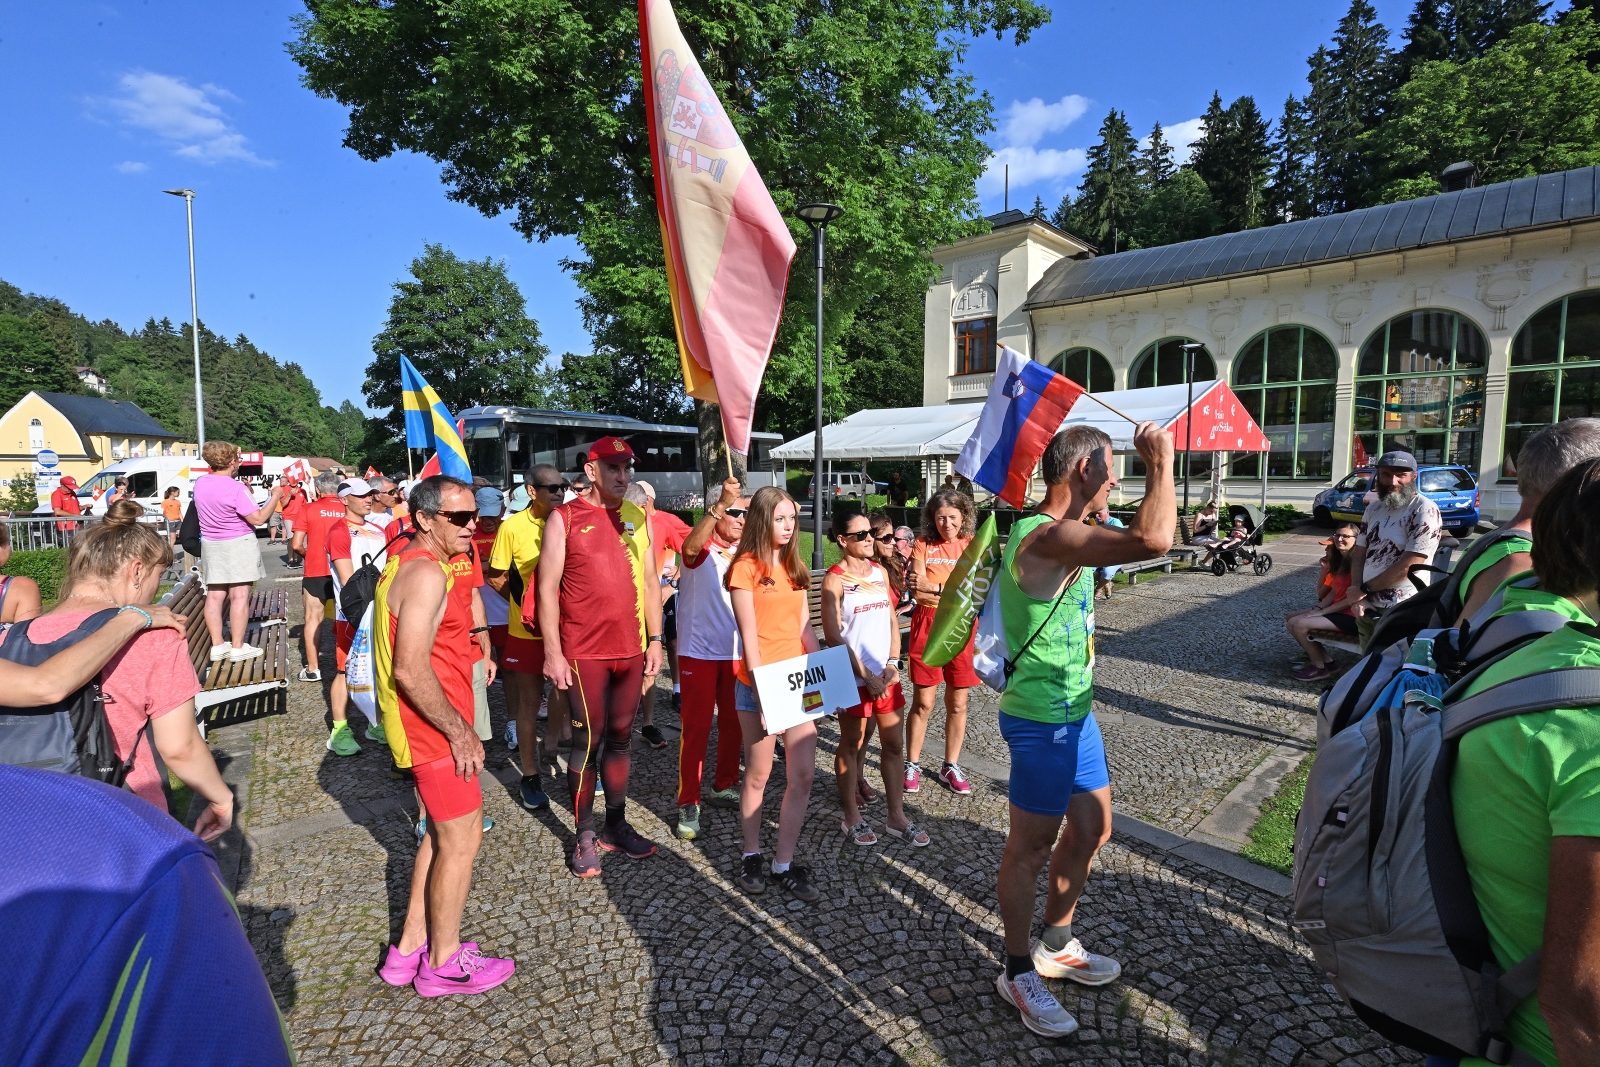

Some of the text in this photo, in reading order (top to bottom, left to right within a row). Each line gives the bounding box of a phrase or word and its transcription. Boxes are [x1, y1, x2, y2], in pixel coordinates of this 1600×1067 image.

[320, 509, 346, 518] Suiss
[926, 557, 958, 566] ESPA
[787, 665, 827, 691] SPAIN
[571, 719, 583, 729] ESP
